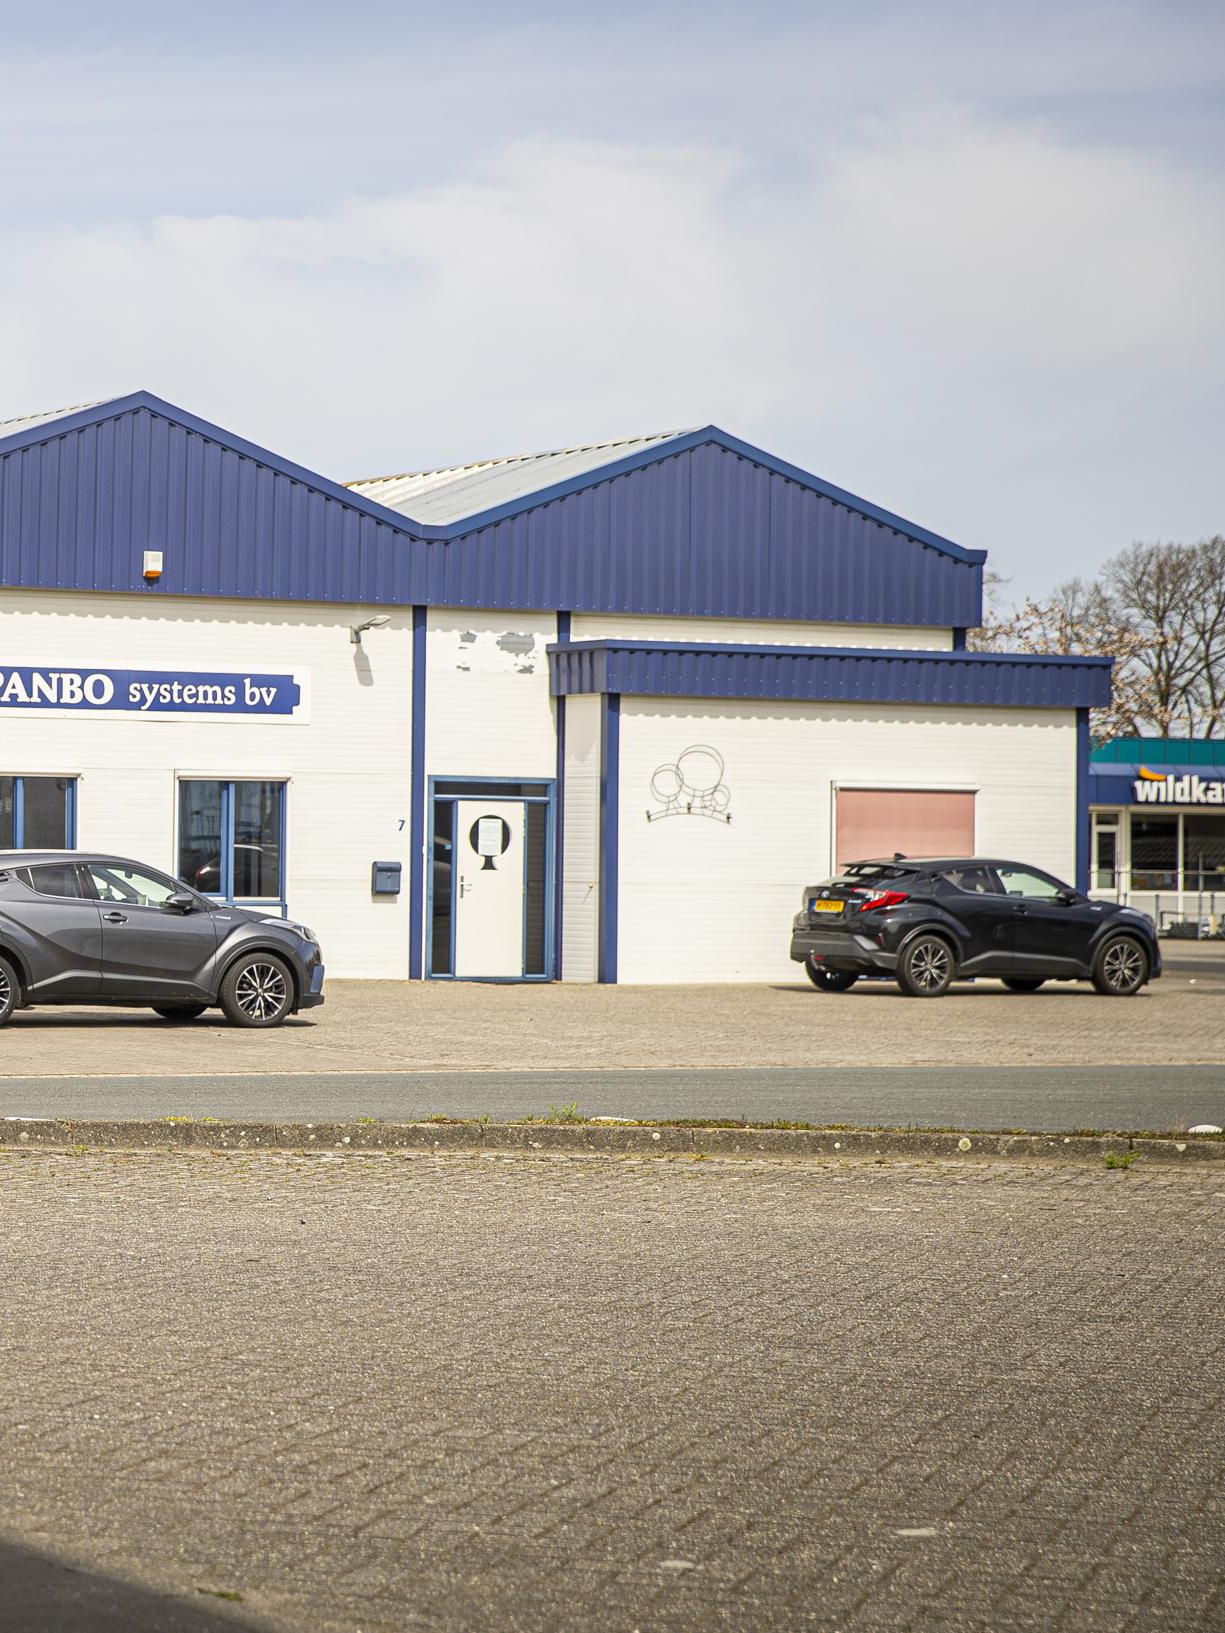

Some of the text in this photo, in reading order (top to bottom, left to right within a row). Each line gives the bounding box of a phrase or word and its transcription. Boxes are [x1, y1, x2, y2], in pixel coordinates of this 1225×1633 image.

[128, 681, 236, 710] systems
[244, 678, 277, 706] bv
[1134, 774, 1225, 803] wildka
[398, 819, 405, 831] 7
